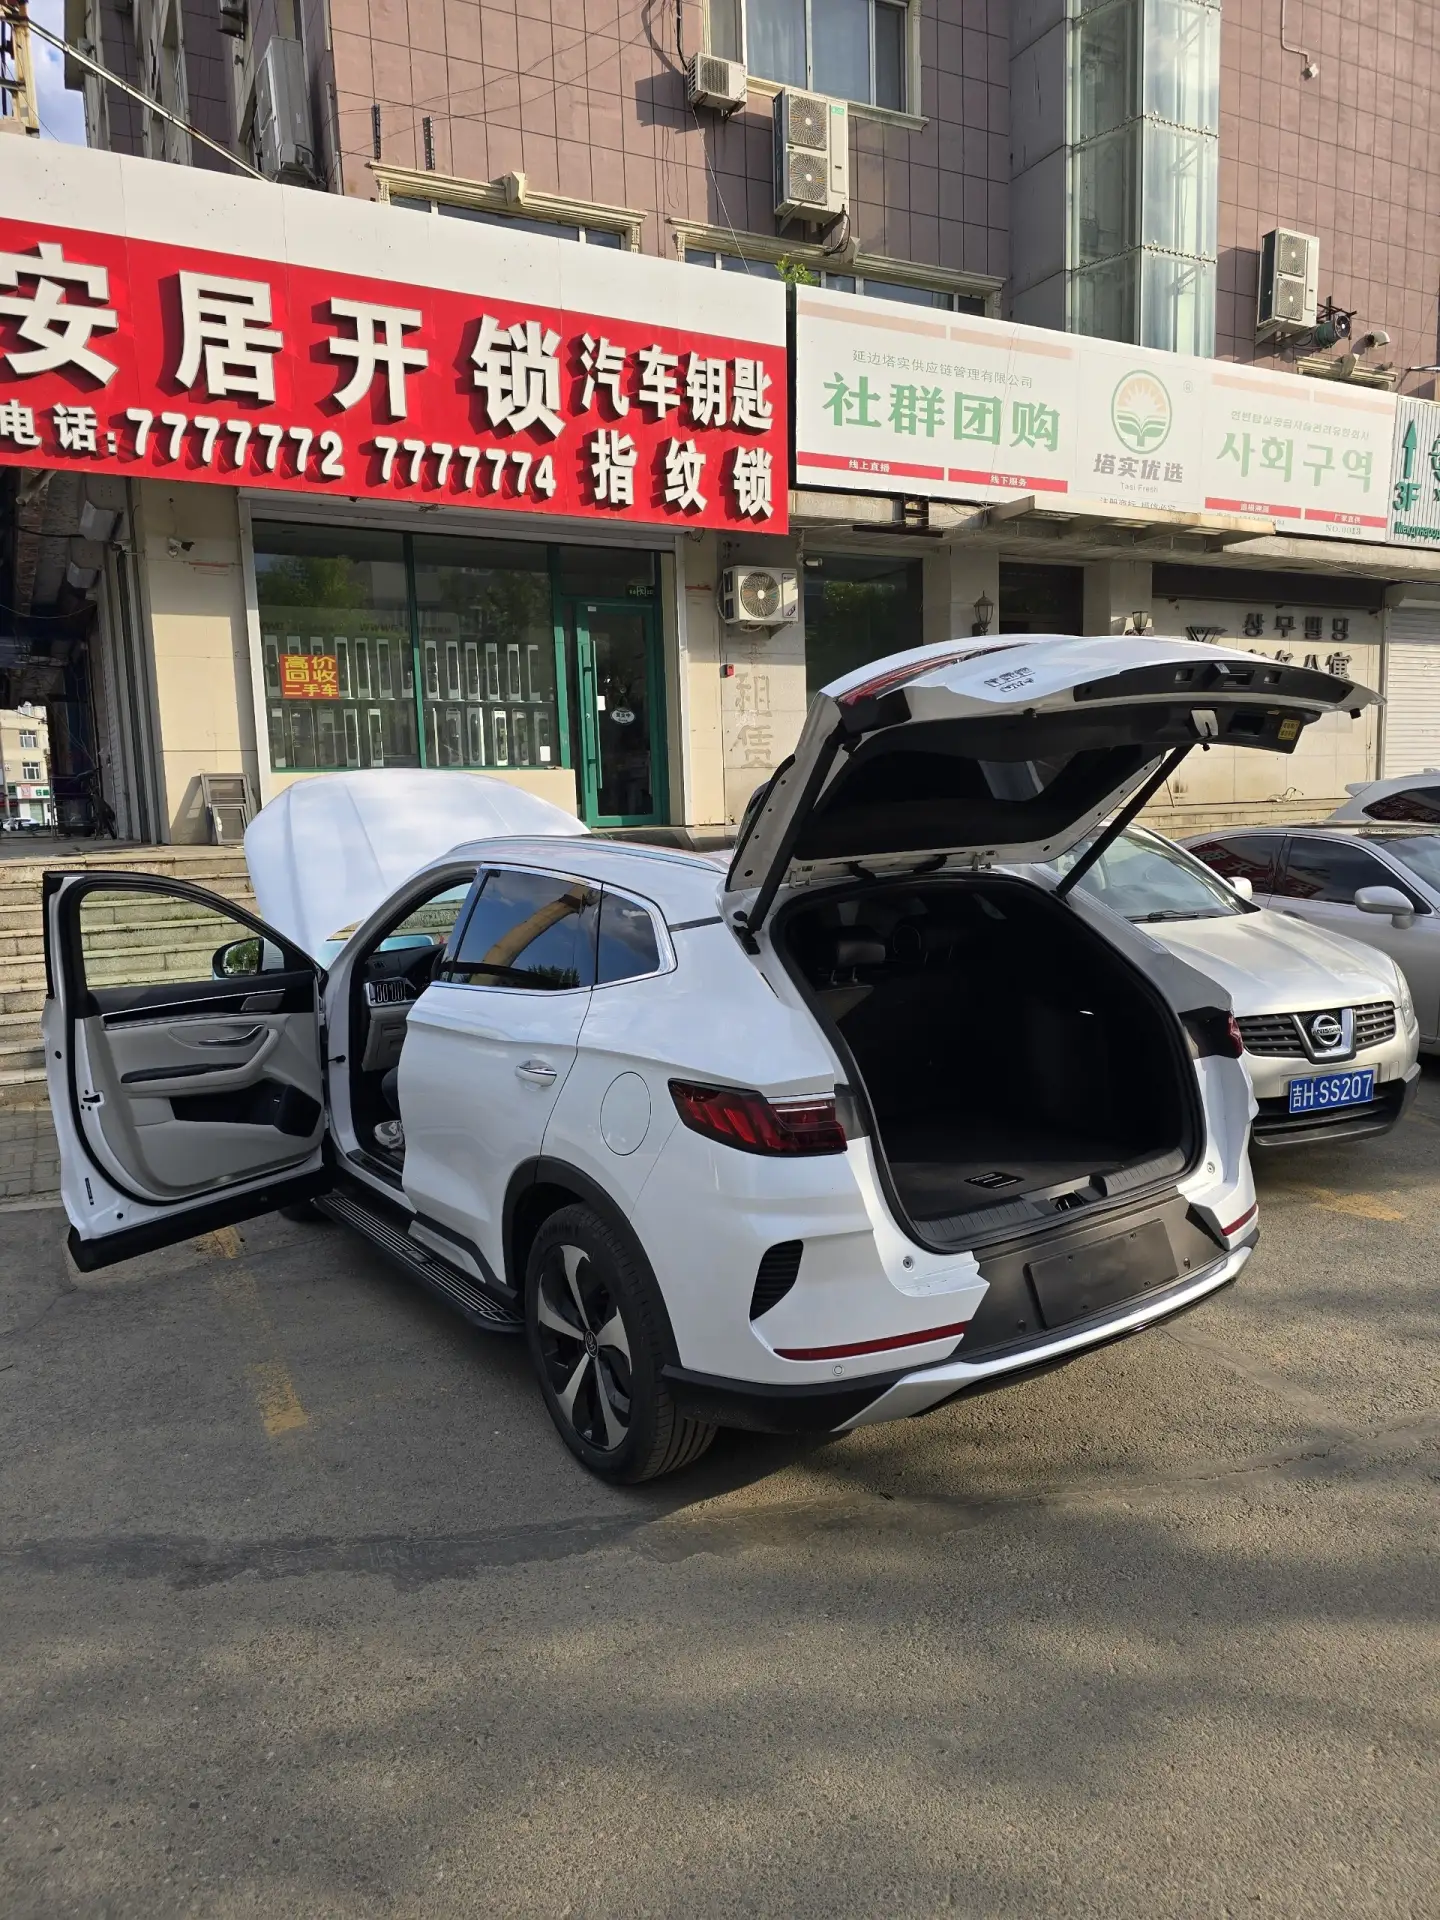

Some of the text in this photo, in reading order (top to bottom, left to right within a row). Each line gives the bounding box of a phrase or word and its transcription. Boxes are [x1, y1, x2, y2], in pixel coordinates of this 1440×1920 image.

[0, 242, 566, 438] 安居开锁
[580, 332, 774, 431] 汽车钥匙
[852, 349, 1032, 388] 延边塔实供应链管理有限公司
[822, 372, 1061, 452] 社群团购
[375, 436, 556, 498] 7777774
[591, 429, 774, 520] 指纹锁
[849, 459, 891, 473] 线上直播
[1093, 453, 1184, 483] 塔实优选
[1216, 432, 1374, 493] 사회구역
[990, 474, 1028, 487] 线下服务
[1392, 481, 1422, 512] 3F
[284, 656, 336, 669] 高价
[285, 669, 337, 682] 回收
[285, 683, 338, 696] 二手车
[1316, 1025, 1341, 1035] NISSAN
